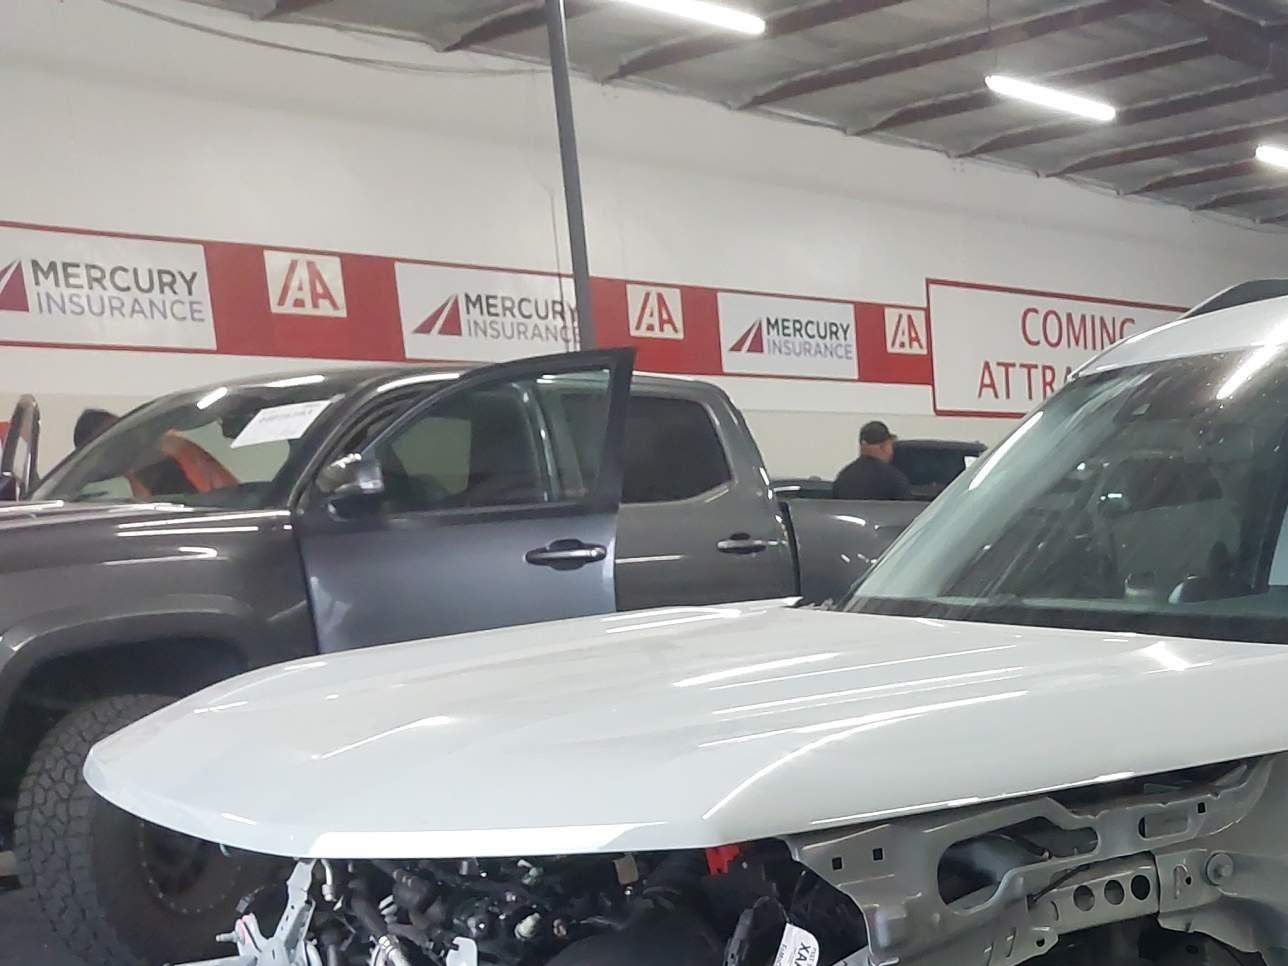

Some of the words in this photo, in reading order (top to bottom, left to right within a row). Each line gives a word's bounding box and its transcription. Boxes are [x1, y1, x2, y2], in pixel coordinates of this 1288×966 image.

[31, 258, 198, 297] MERCURY
[36, 291, 206, 323] INSURANCE
[765, 316, 851, 342] MERCURY
[766, 337, 854, 361] INSURANCE
[977, 360, 1072, 401] ATTR
